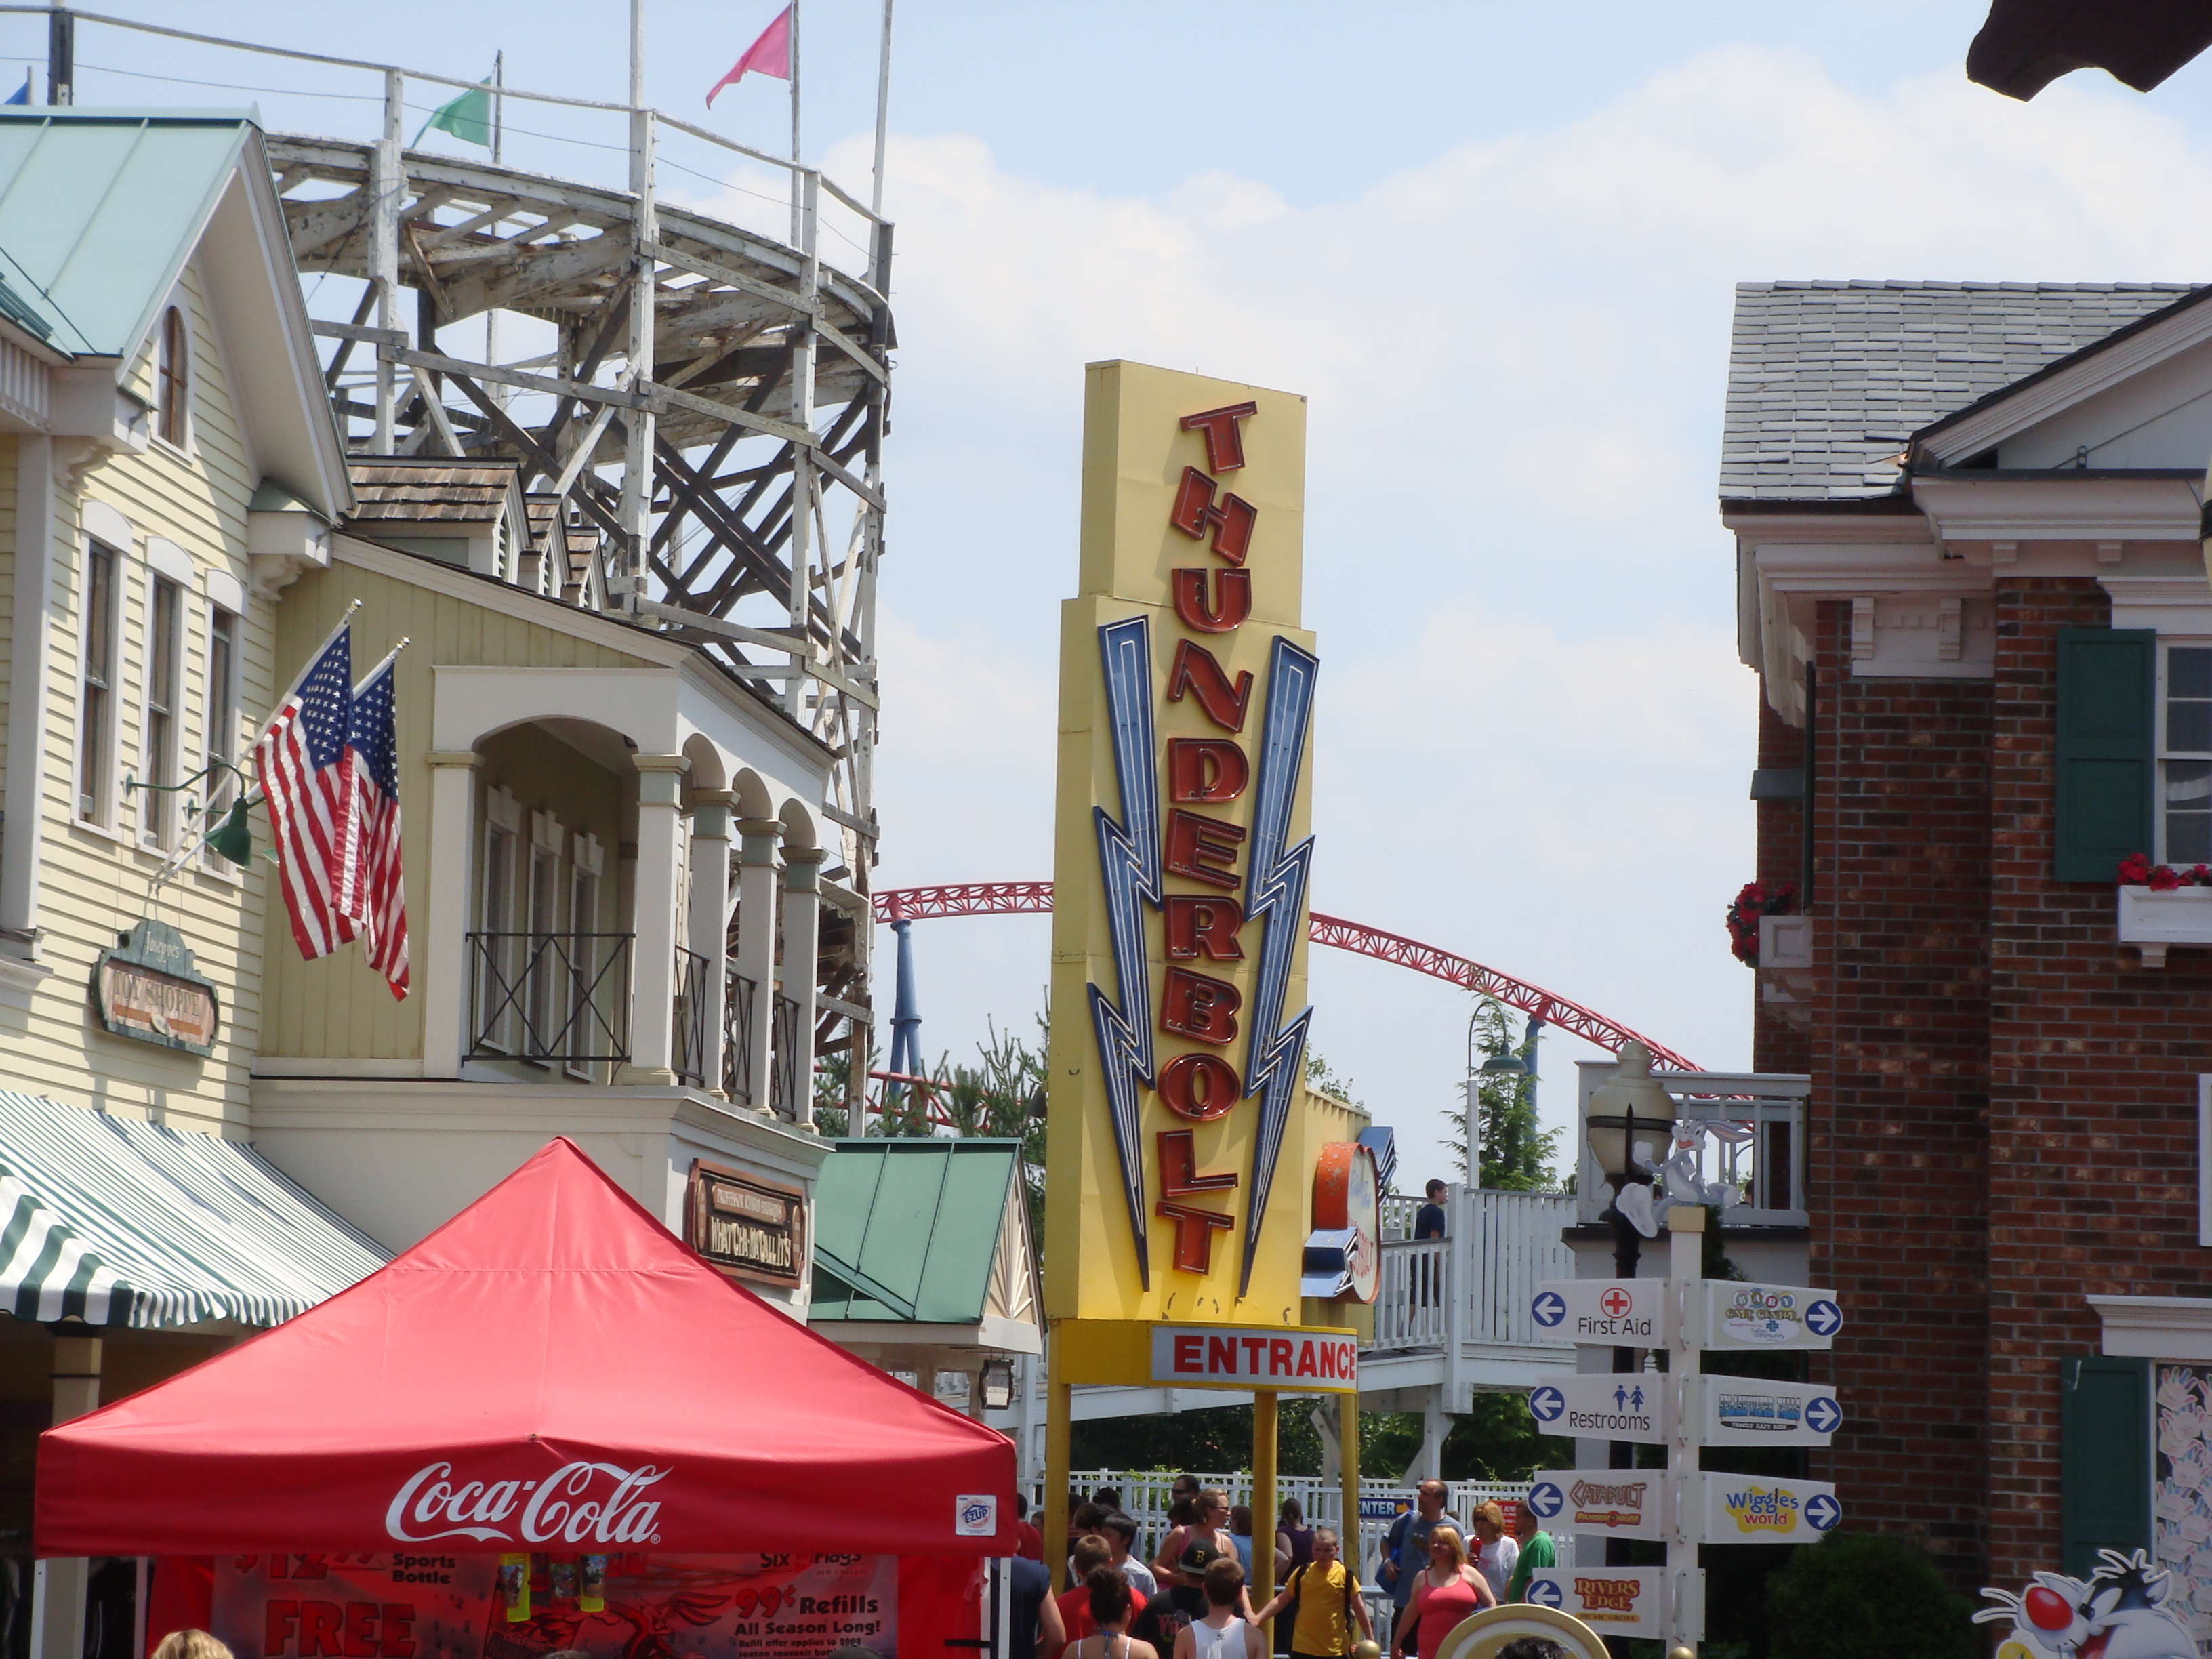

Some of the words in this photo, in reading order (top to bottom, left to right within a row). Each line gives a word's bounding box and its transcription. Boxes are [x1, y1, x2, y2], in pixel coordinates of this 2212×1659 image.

[1155, 401, 1258, 1276] THUNDERBOLT
[113, 970, 141, 1000] TOY
[146, 981, 200, 1017] SHOPPE
[1735, 1291, 1794, 1308] BABY
[1726, 1309, 1754, 1321] CARE
[1756, 1309, 1797, 1322] CENTER
[1578, 1317, 1617, 1334] First
[1622, 1318, 1652, 1336] Aid
[1173, 1335, 1355, 1380] ENTRANCE
[1569, 1411, 1650, 1431] Restrooms
[385, 1461, 674, 1544] Coca-Cola
[1570, 1480, 1647, 1509] CATAPULT
[1726, 1488, 1799, 1514] Wiggles
[1744, 1513, 1788, 1525] world
[392, 1553, 457, 1569] Sports
[760, 1553, 791, 1568] Six
[1195, 1550, 1205, 1563] B
[392, 1570, 451, 1584] Bottle
[1576, 1579, 1639, 1595] RIVERS
[735, 1584, 797, 1619] 99¢
[800, 1595, 879, 1615] Refills
[1585, 1595, 1631, 1610] EDGE
[264, 1599, 417, 1659] FREE
[735, 1623, 759, 1635] All
[765, 1622, 827, 1635] Season
[833, 1620, 881, 1636] Long!
[739, 1638, 763, 1647] Refill
[765, 1639, 787, 1647] offer
[790, 1638, 825, 1649] applies
[827, 1638, 836, 1646] to
[773, 1648, 813, 1658] souvenir
